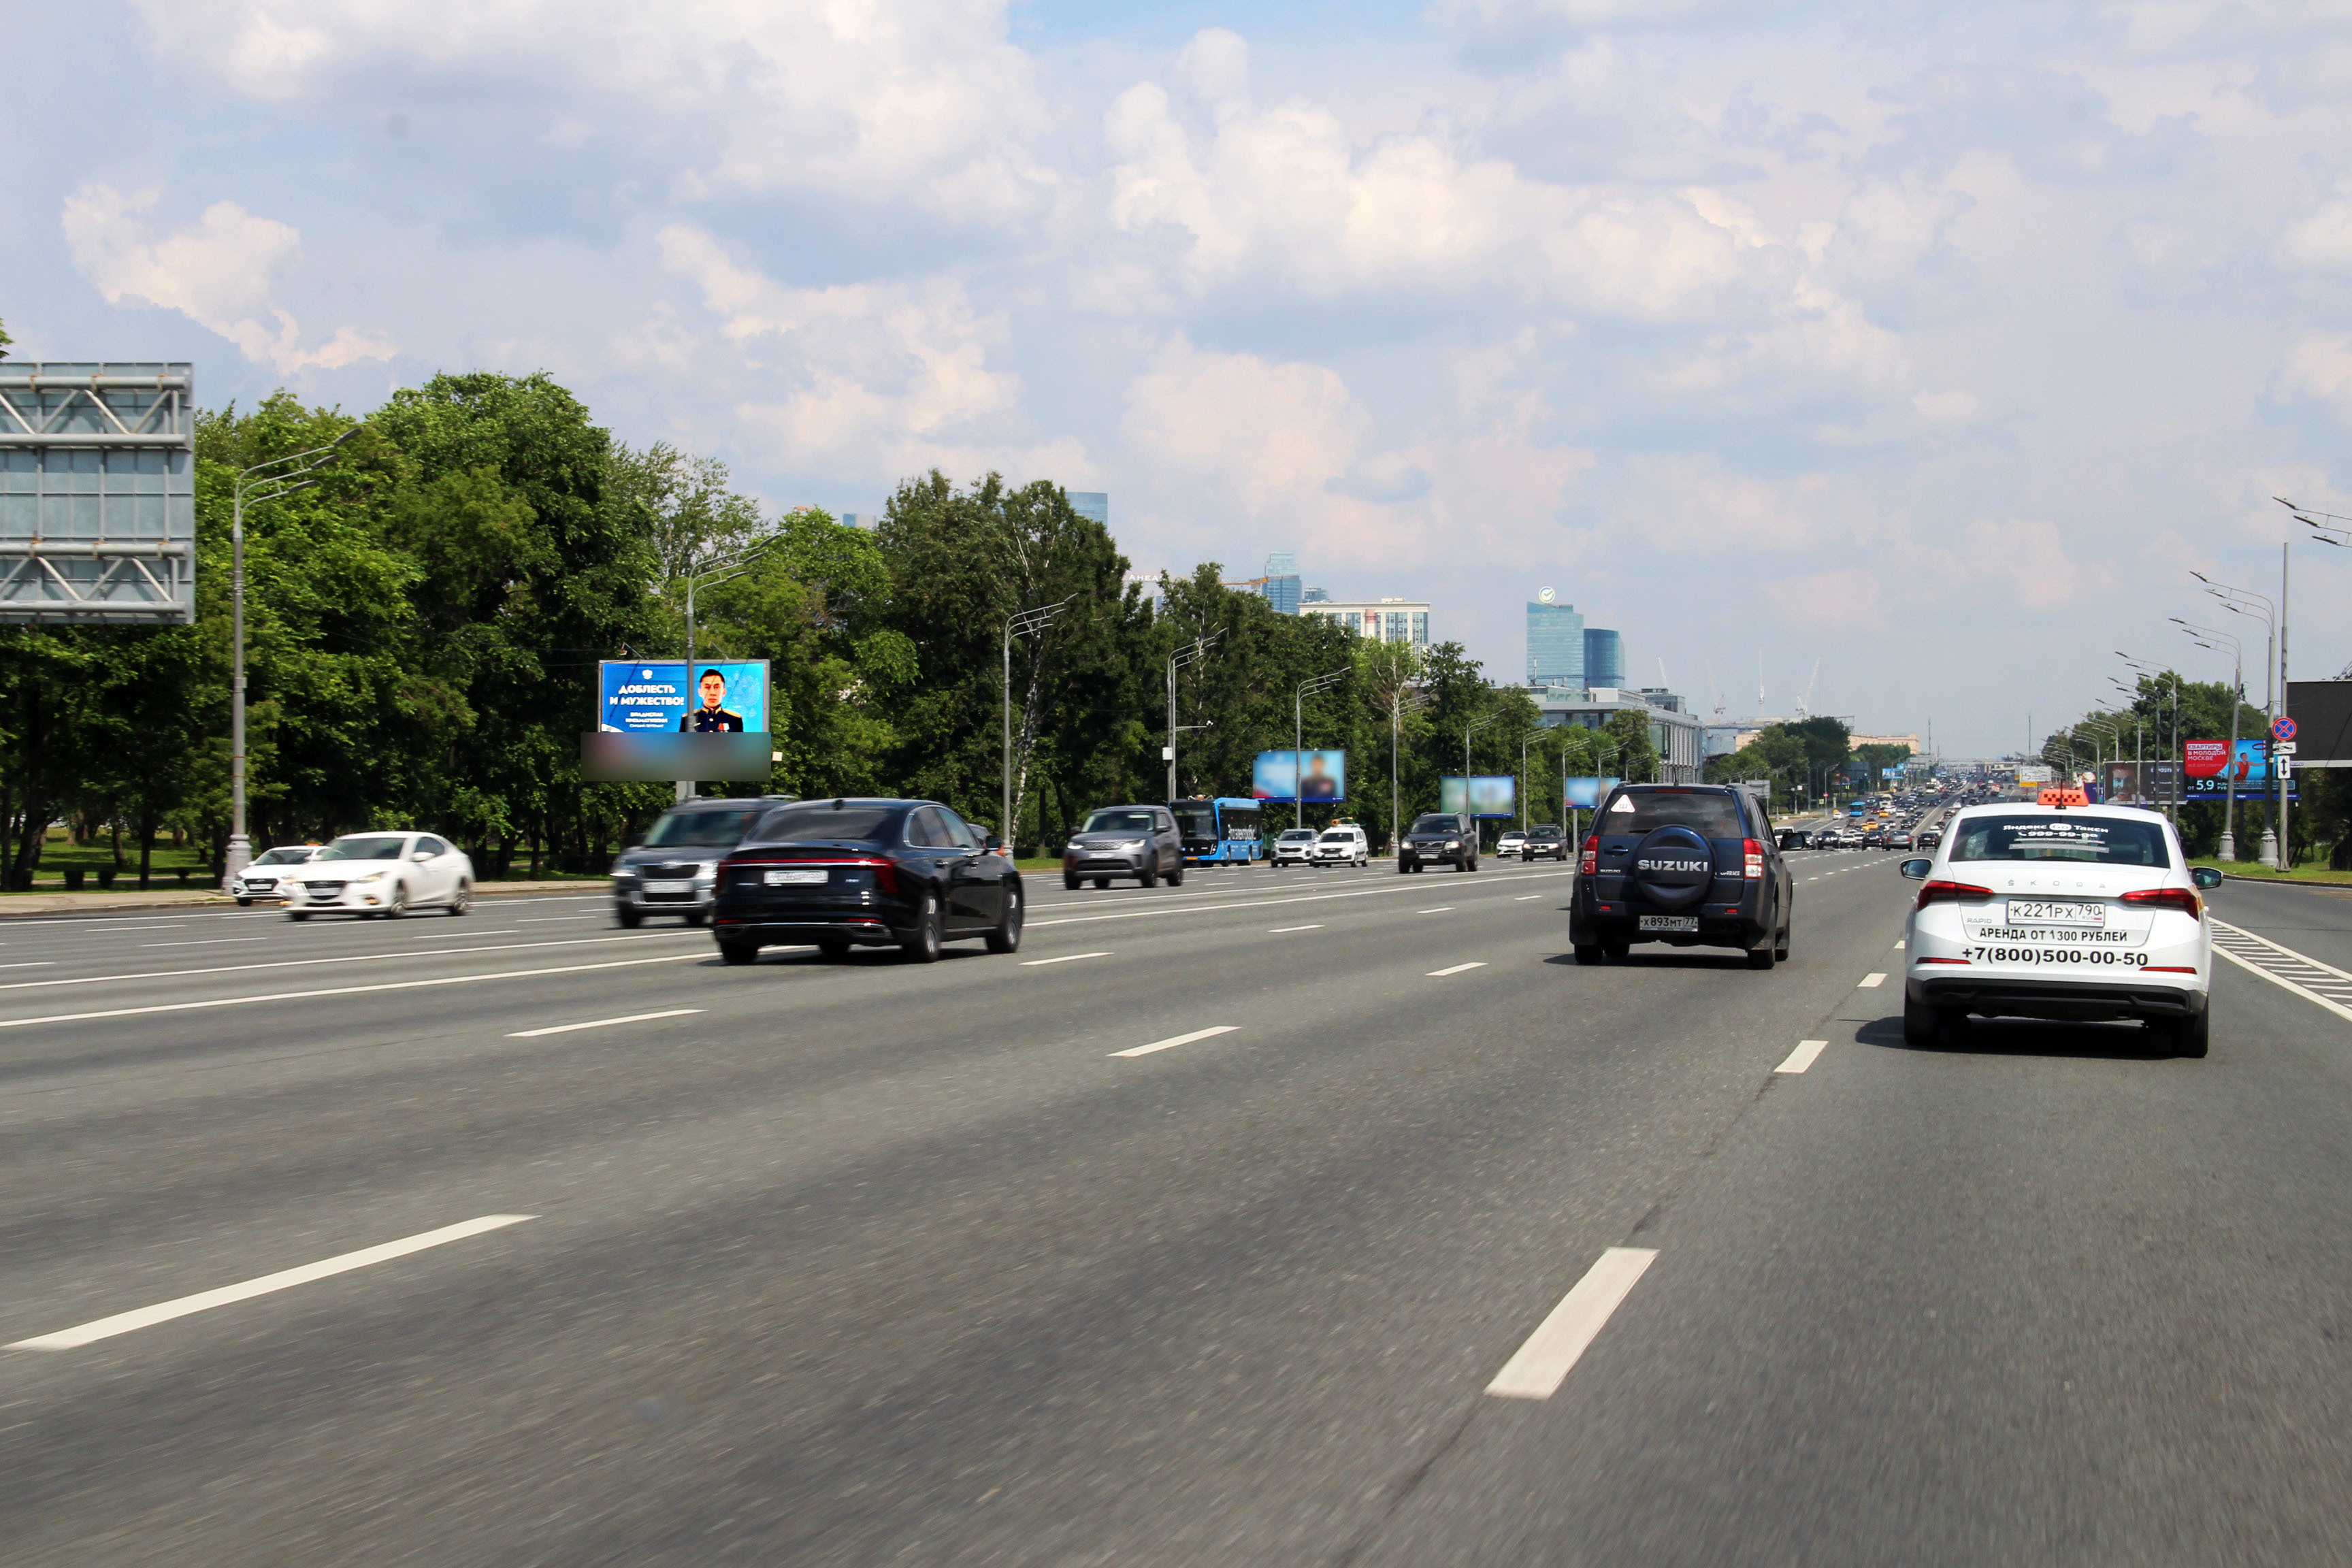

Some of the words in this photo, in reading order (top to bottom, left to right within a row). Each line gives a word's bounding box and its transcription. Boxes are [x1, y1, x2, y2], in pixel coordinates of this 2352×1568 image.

[618, 685, 676, 694] ДОБЛЕСТЬ
[609, 697, 619, 705] И
[620, 696, 685, 705] МУЖЕСТВО!
[2195, 779, 2215, 791] 5,9
[2073, 825, 2109, 833] Такси
[1637, 860, 1709, 872] SUZUKI
[1979, 928, 2026, 941] АРЕНДА
[2030, 930, 2046, 940] ОТ
[2050, 930, 2077, 941] 1300
[2081, 930, 2127, 942] РУБЛЕЙ
[1961, 947, 2149, 966] +7(800)500-00-50
